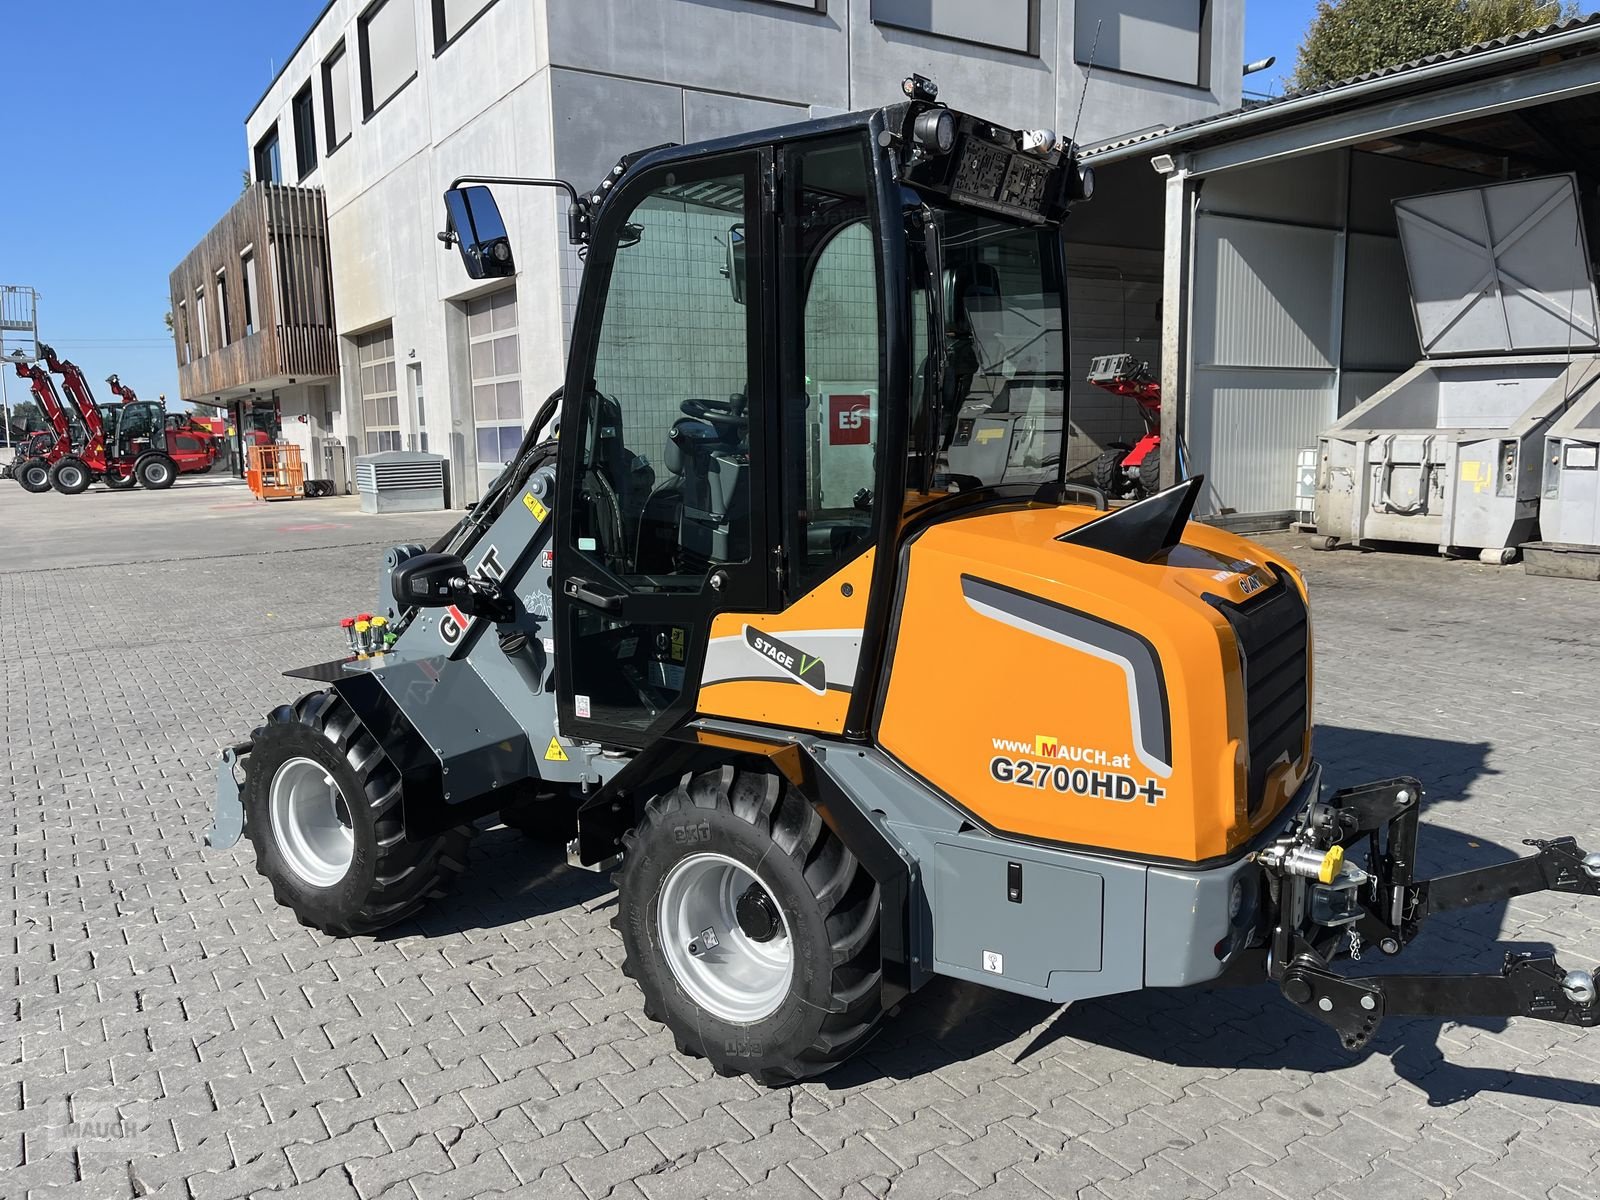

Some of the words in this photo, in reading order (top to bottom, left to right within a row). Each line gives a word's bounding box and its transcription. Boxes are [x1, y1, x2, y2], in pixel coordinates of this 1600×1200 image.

[839, 411, 861, 429] E5
[754, 637, 794, 669] STAGE
[799, 654, 821, 676] V
[990, 756, 1165, 806] G2700HD+
